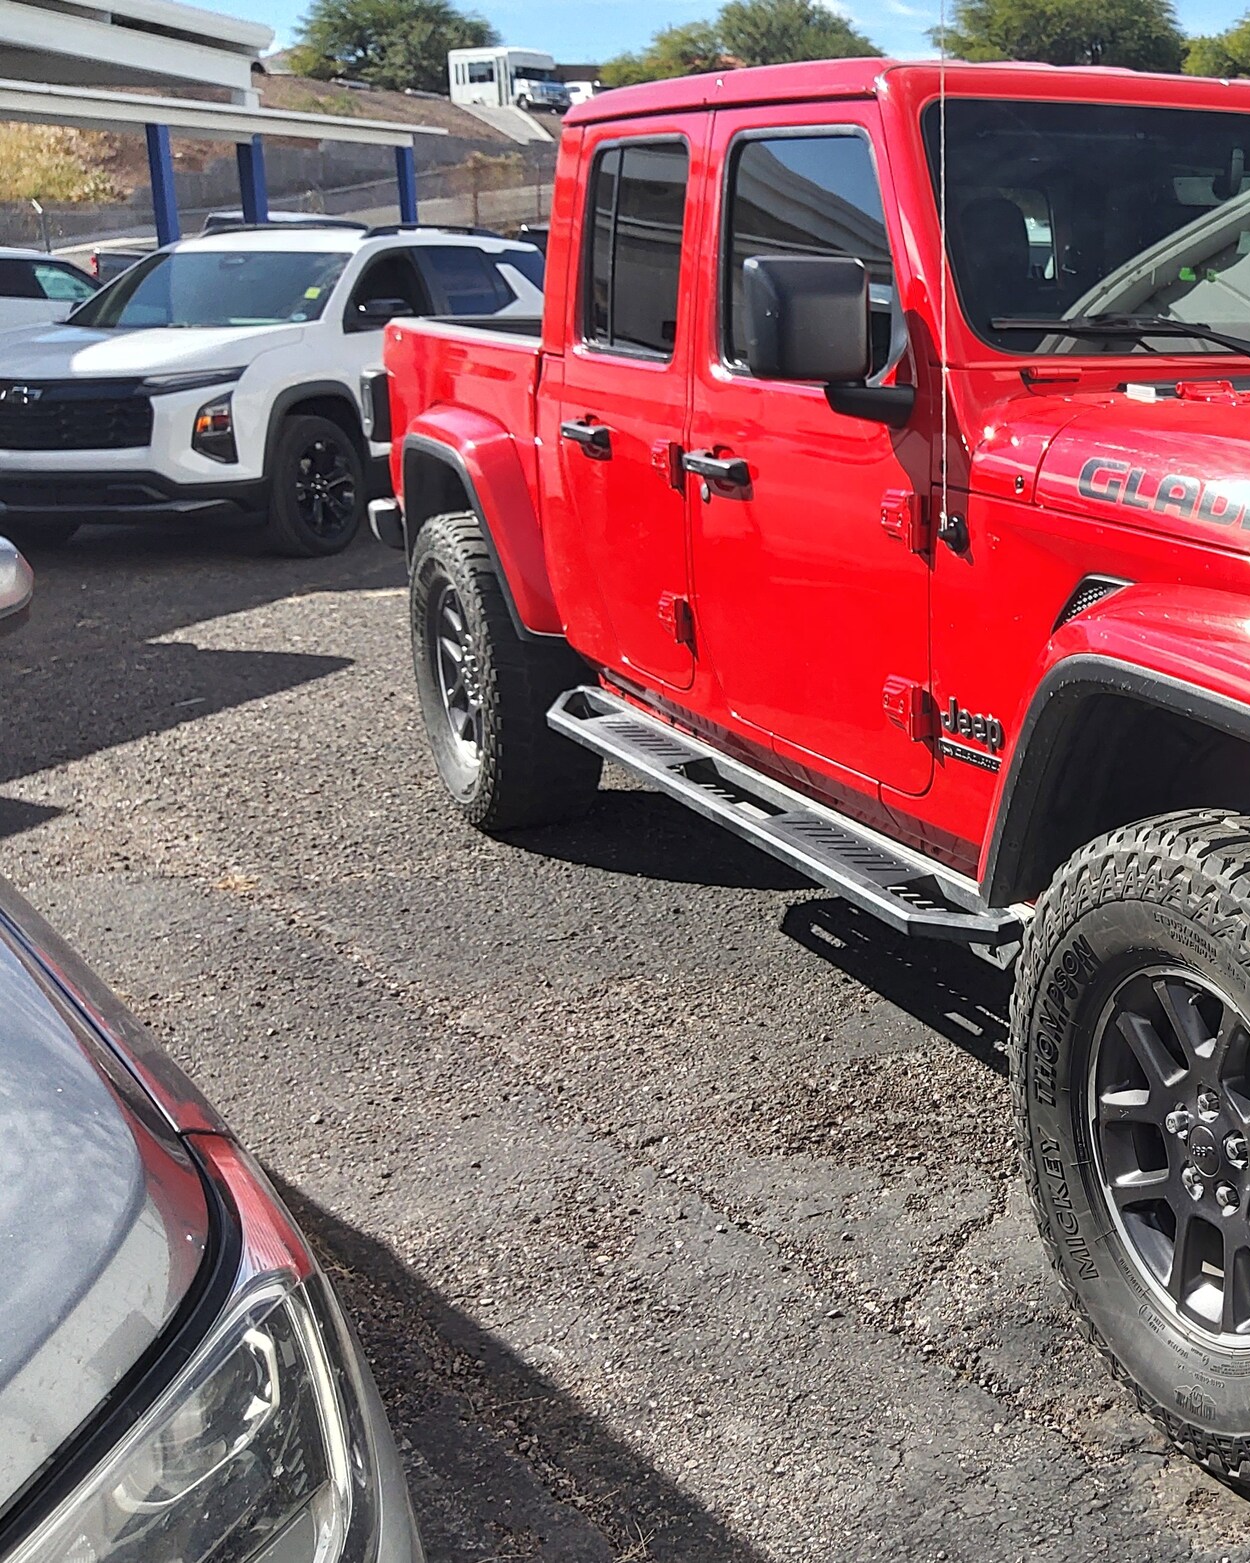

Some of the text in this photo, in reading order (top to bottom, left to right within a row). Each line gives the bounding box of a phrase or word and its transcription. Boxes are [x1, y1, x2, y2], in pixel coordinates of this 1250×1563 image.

[940, 697, 1005, 755] Jeep
[1034, 934, 1100, 1280] MICKEY THOMPSON
